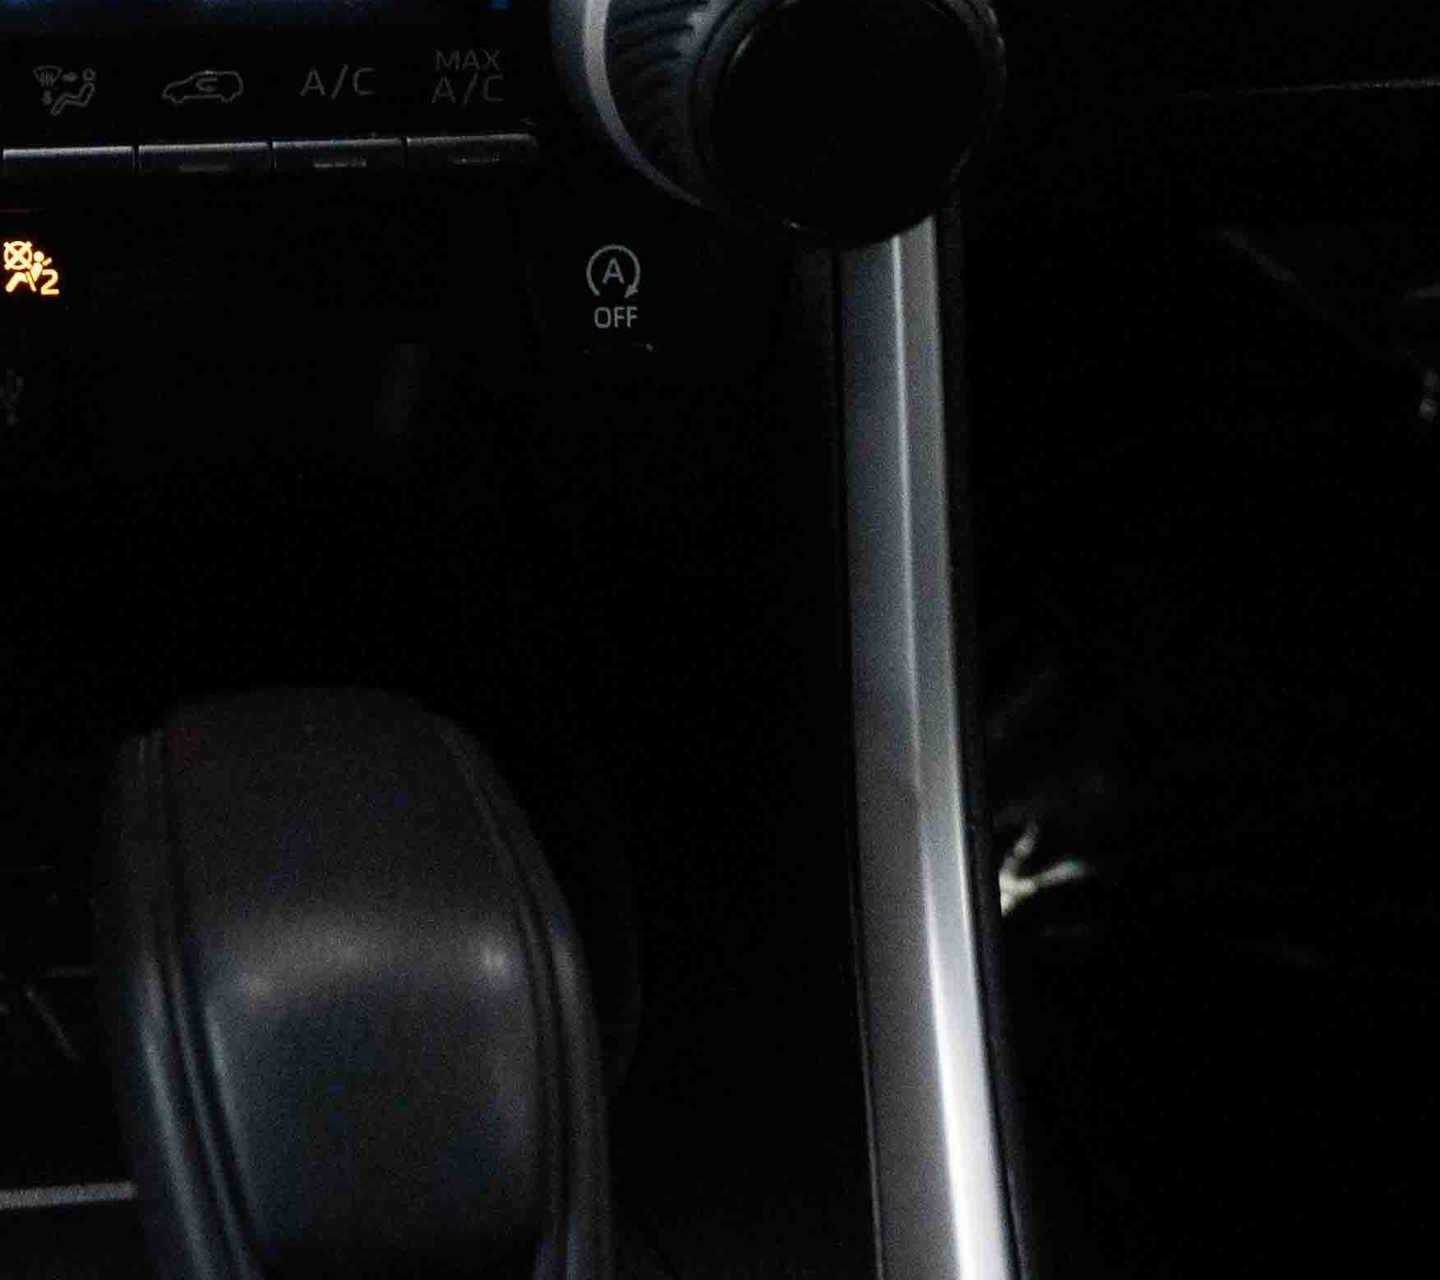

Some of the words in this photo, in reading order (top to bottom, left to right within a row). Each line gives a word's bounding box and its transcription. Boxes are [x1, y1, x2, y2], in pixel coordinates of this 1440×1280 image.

[434, 49, 501, 73] MAX
[300, 65, 376, 100] A/C
[431, 75, 505, 105] A/C
[601, 257, 625, 285] A
[593, 306, 639, 329] OFF
